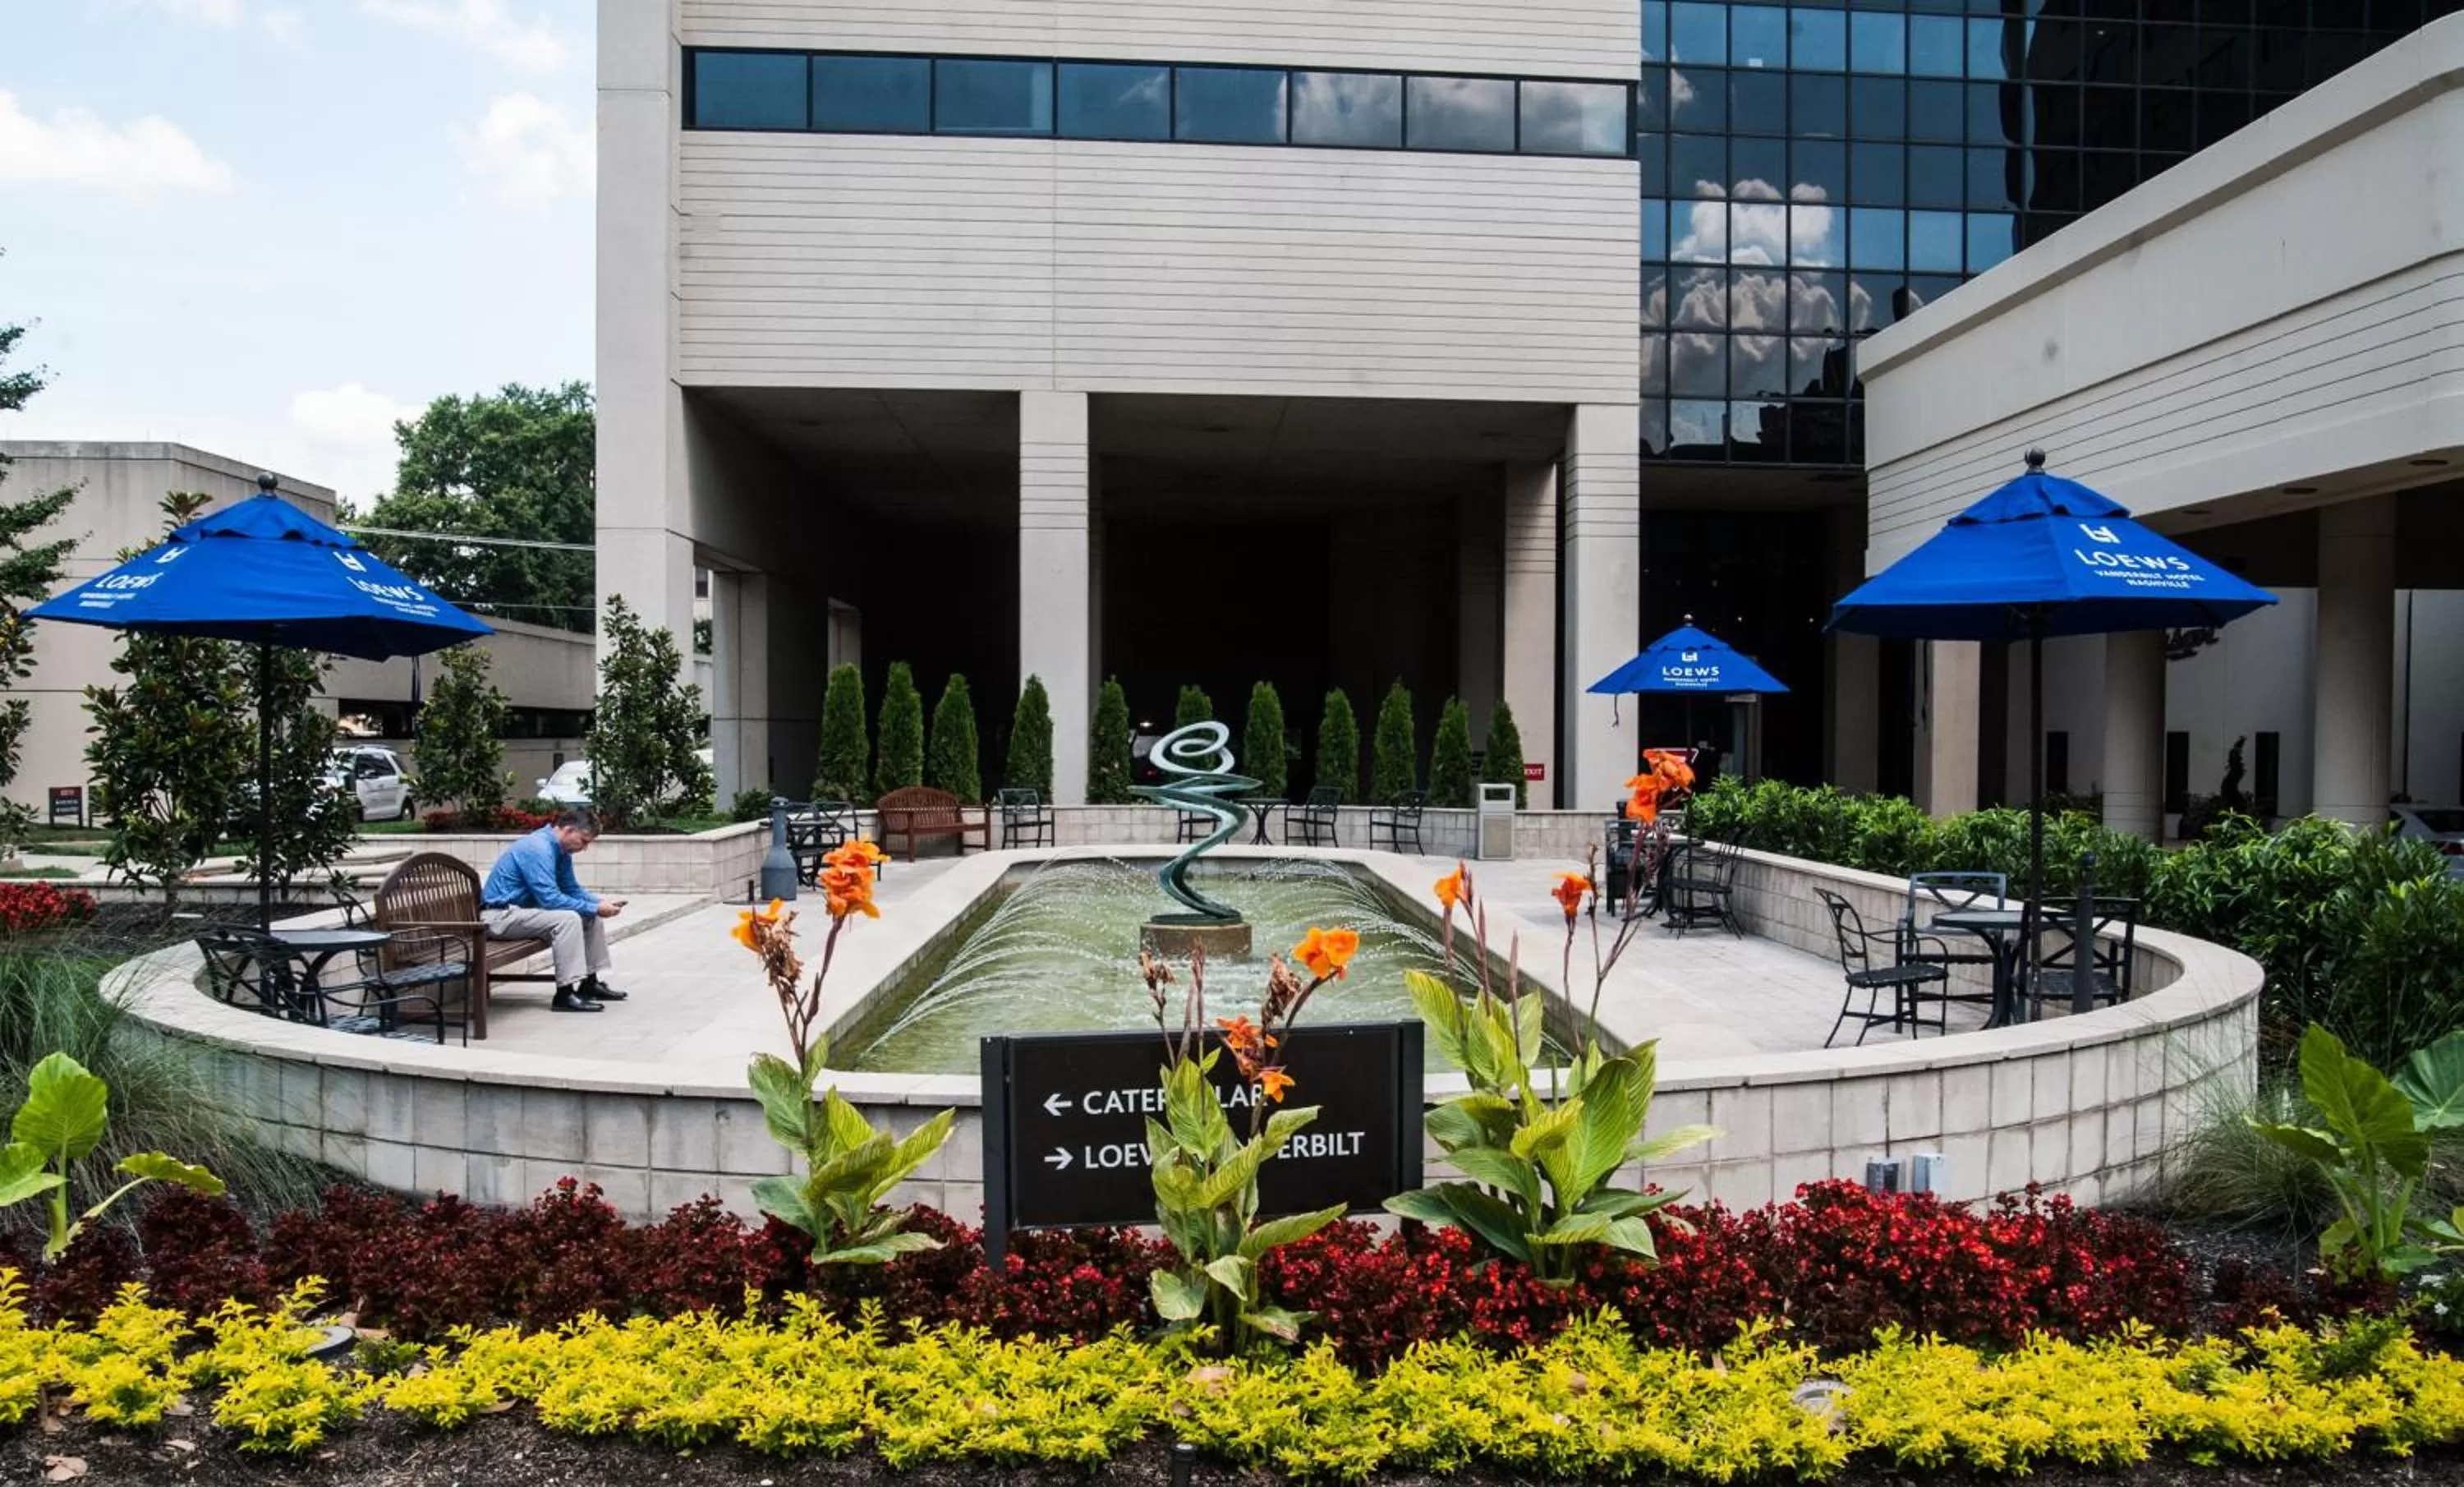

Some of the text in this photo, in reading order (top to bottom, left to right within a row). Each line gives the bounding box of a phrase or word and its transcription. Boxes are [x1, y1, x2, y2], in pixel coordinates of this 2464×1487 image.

[2074, 549, 2190, 570] LOEWS
[1662, 665, 1720, 676] LOEWS
[1083, 1084, 1268, 1115] CATERLAR
[1084, 1131, 1365, 1169] LOE ERBILT
